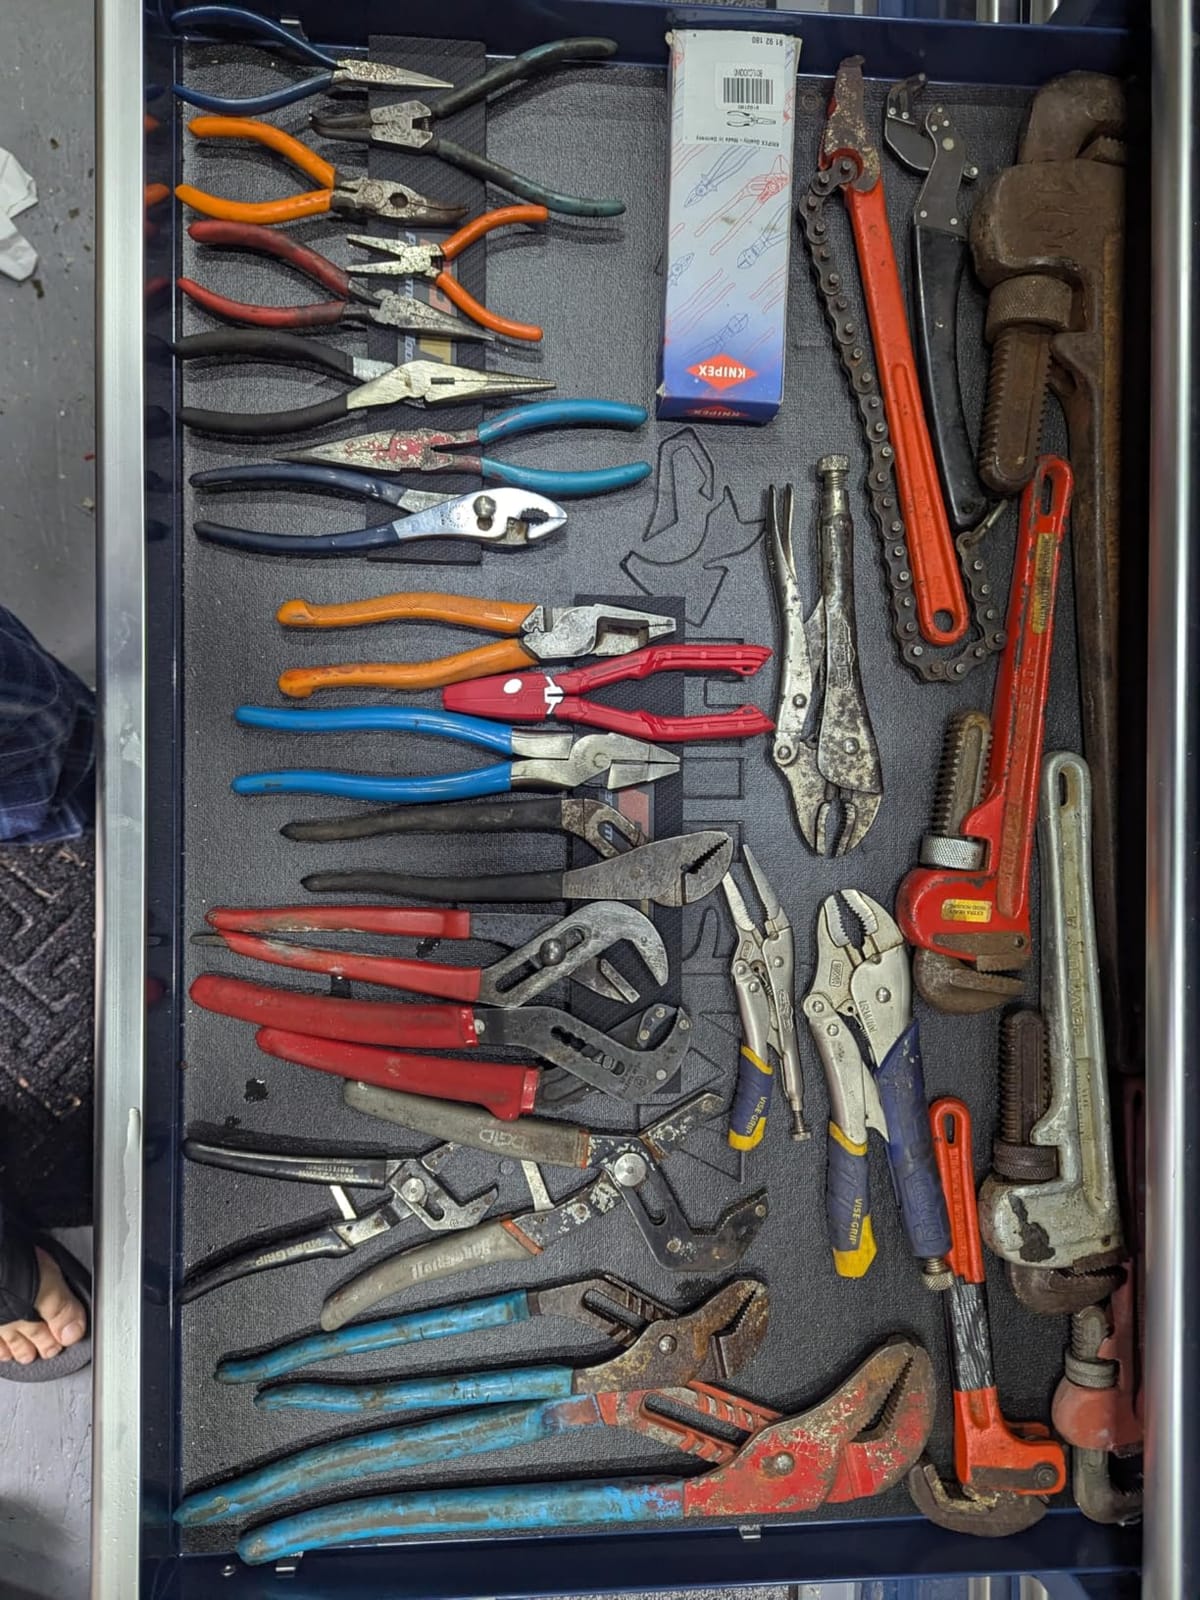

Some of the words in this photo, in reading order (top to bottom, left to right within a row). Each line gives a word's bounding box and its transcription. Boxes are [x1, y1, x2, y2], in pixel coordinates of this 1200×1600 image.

[752, 36, 763, 45] 180
[765, 38, 774, 46] 92
[698, 364, 746, 379] KNIPEX
[693, 408, 741, 417] KNIPEX
[858, 1000, 877, 1033] IRWIN
[848, 1198, 865, 1246] VISE-GRIP
